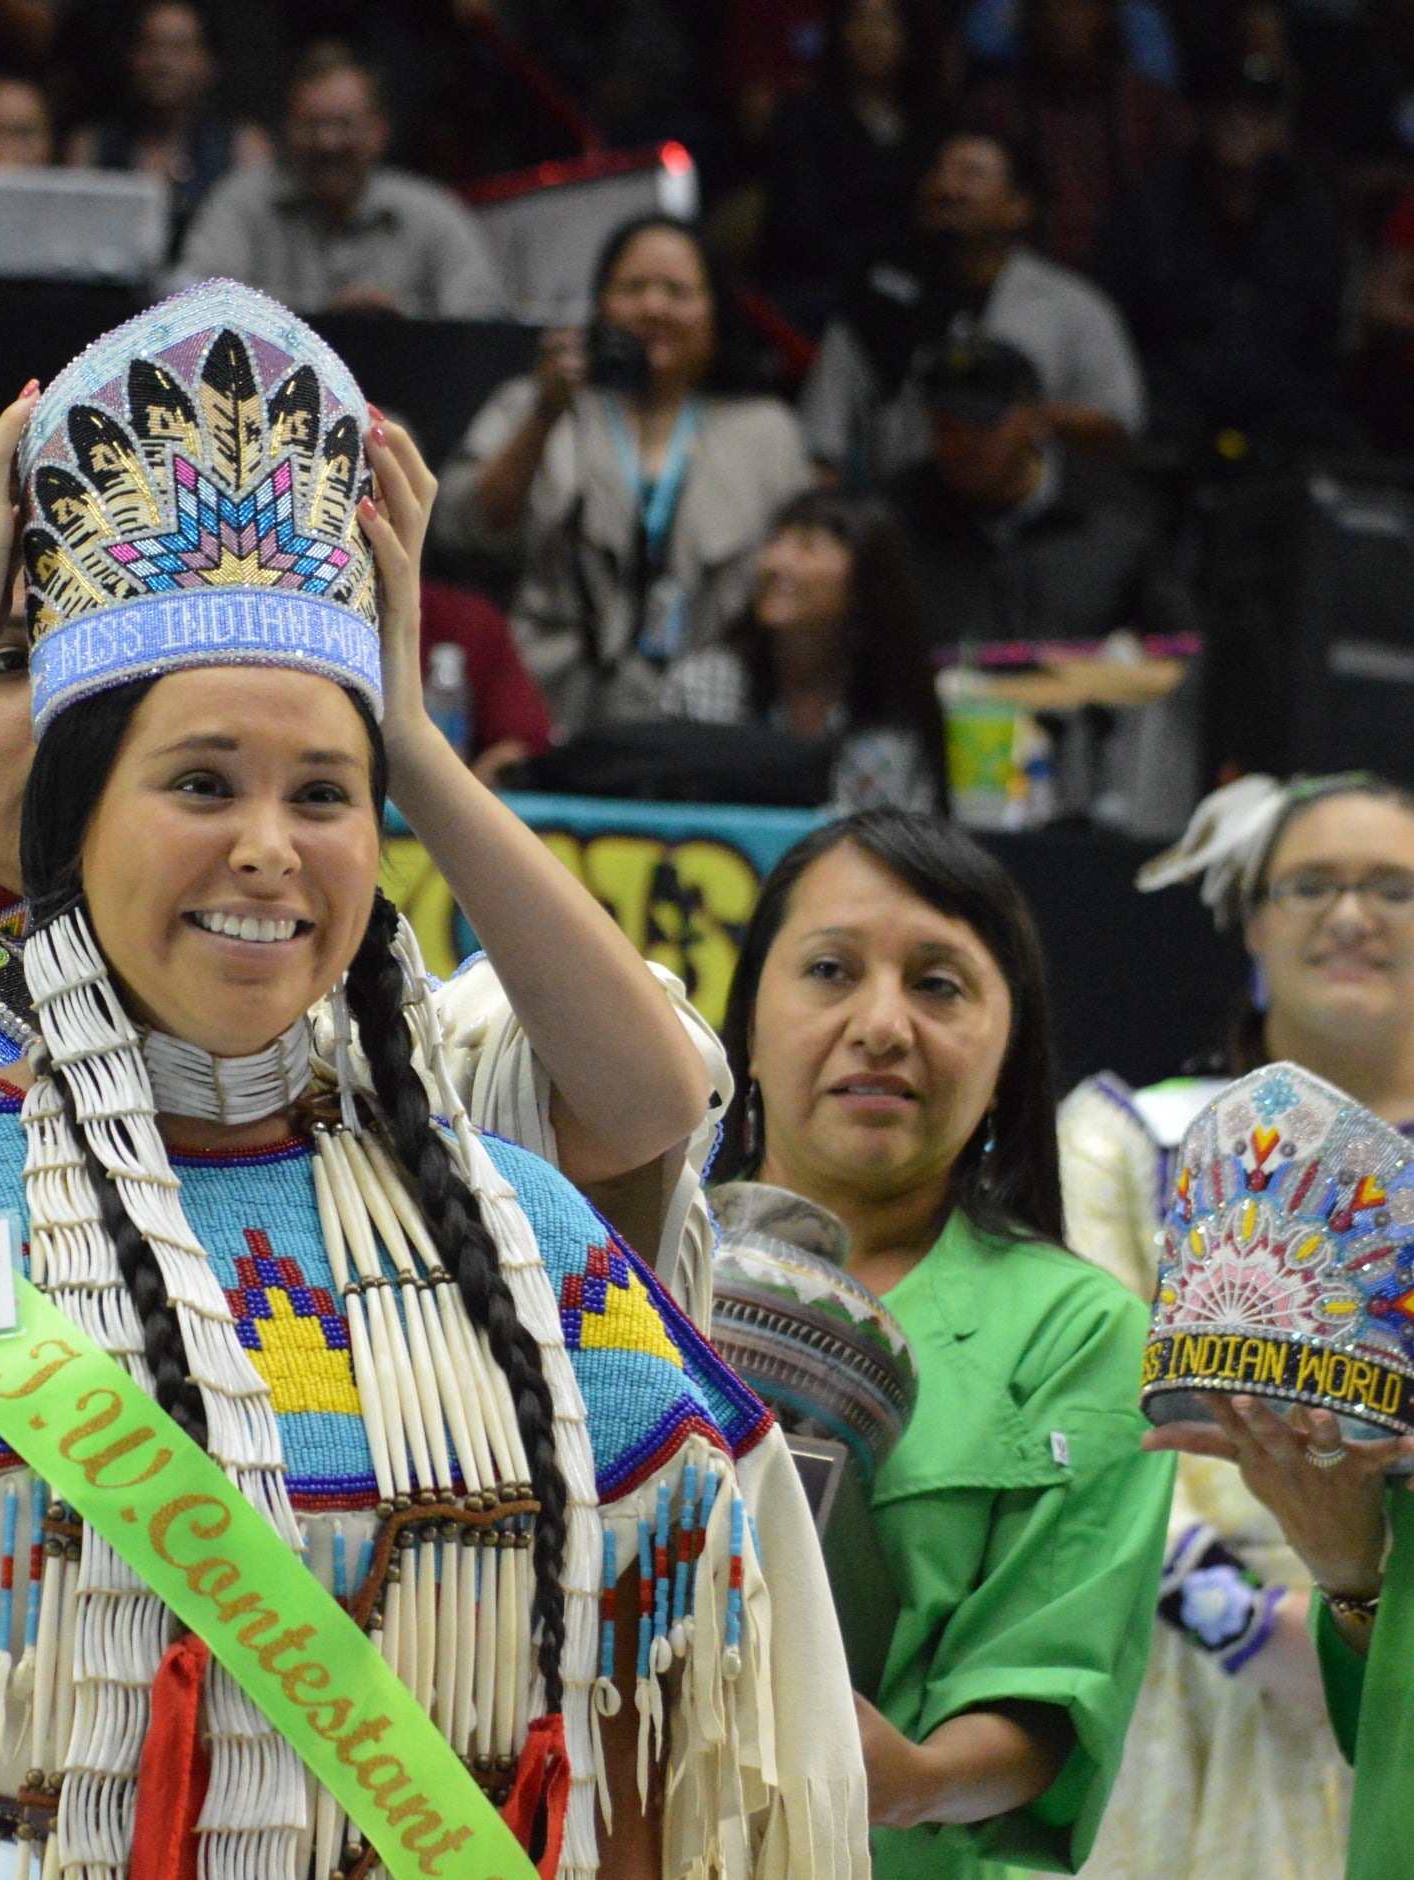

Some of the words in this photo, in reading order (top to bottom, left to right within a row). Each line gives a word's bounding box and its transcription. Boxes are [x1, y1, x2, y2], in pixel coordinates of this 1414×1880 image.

[159, 594, 311, 648] INDIAN
[1163, 1333, 1289, 1385] INDIAN
[1296, 1344, 1403, 1415] WORLD
